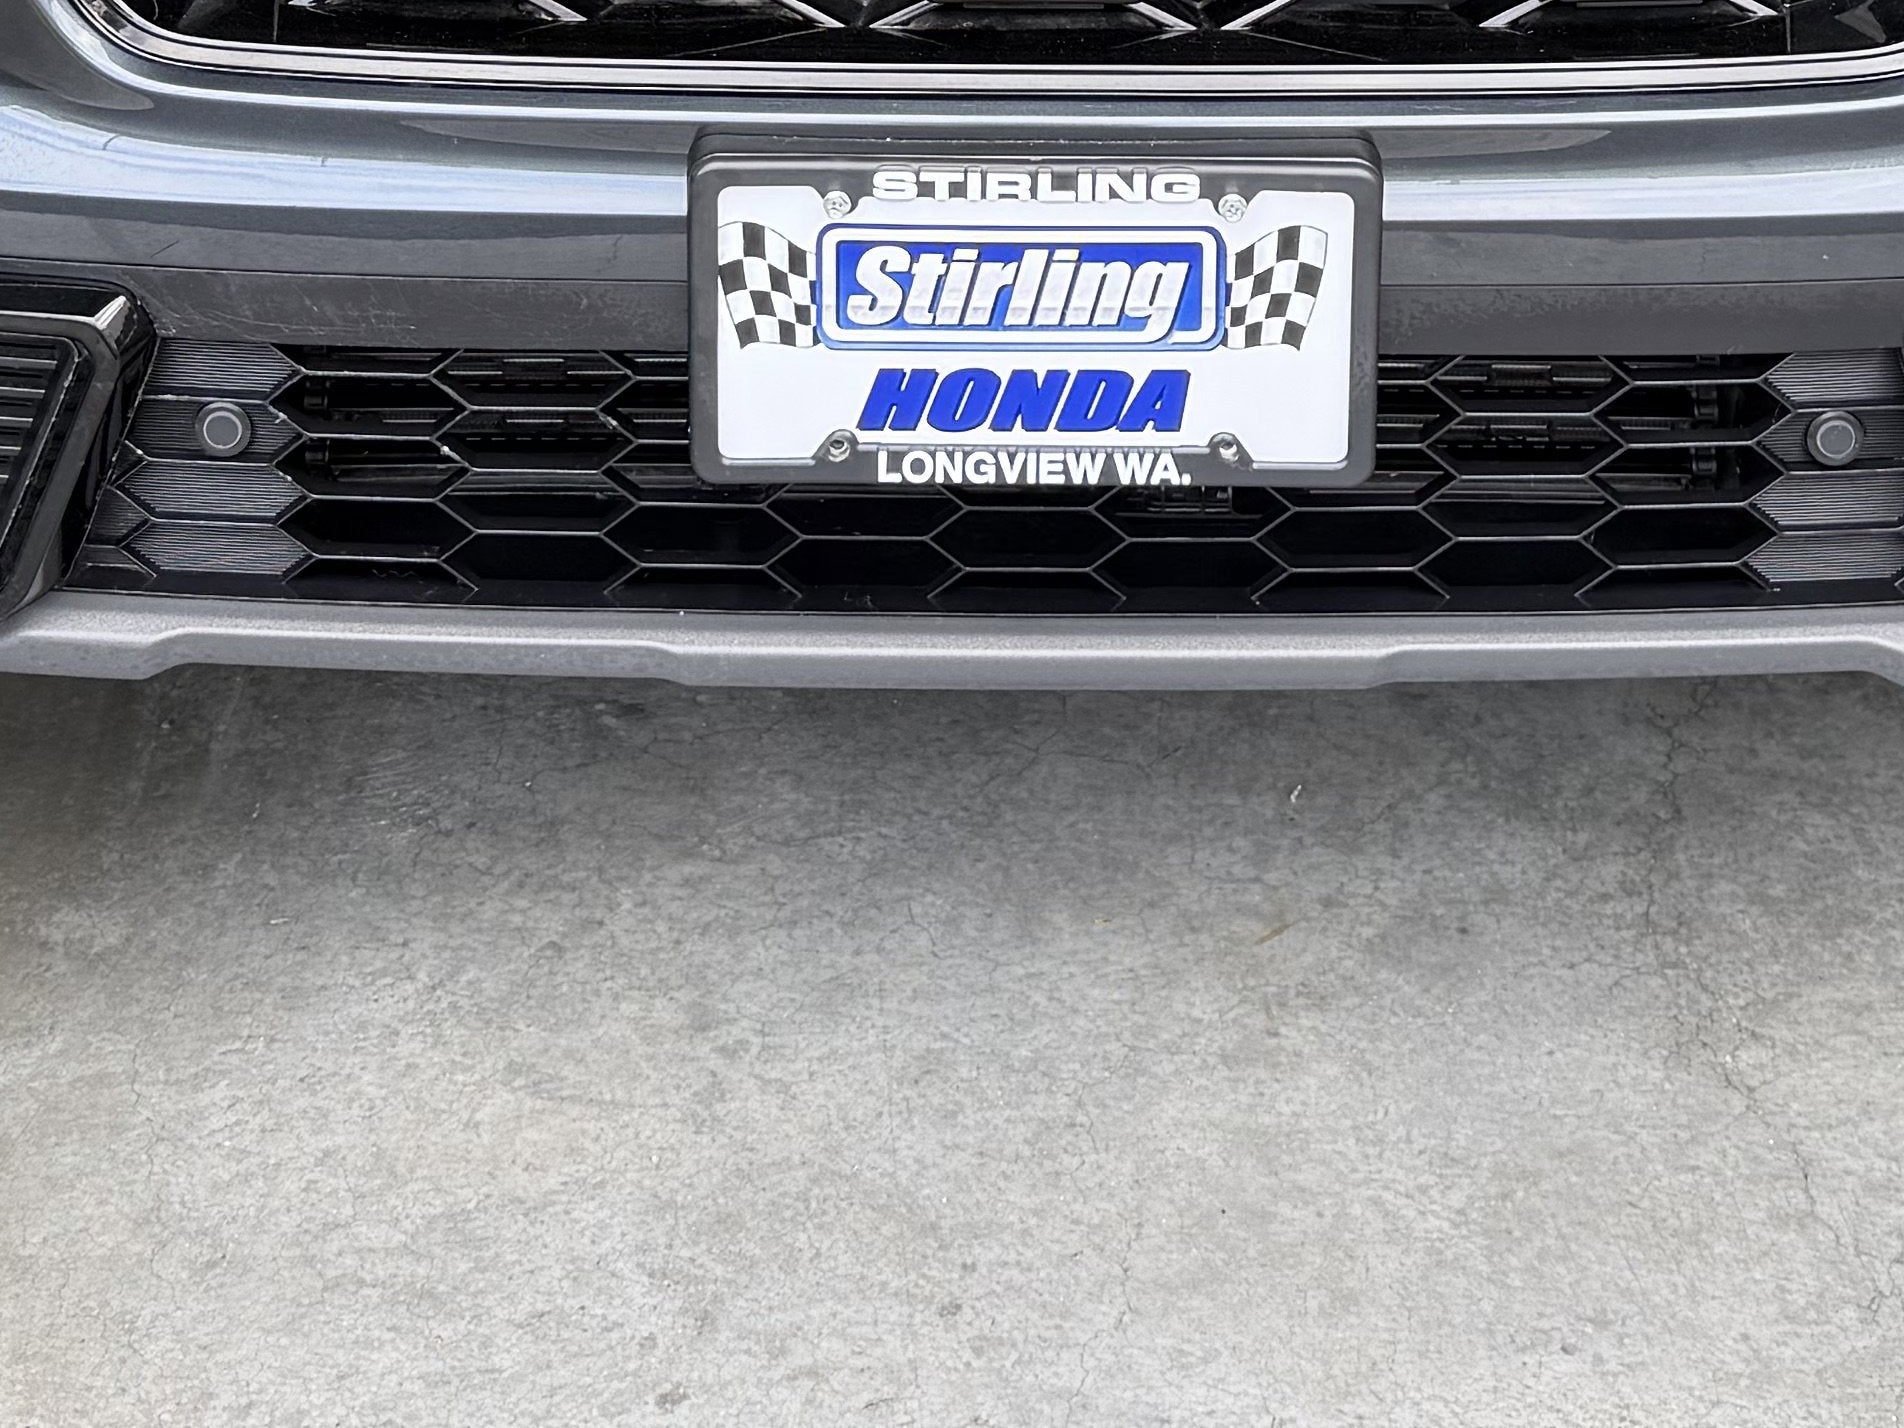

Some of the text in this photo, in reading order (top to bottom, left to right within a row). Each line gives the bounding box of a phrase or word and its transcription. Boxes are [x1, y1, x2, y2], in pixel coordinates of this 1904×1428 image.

[872, 168, 1201, 203] STIRLING
[846, 245, 1190, 342] Stirling
[856, 368, 1191, 432] HONDA
[877, 449, 1192, 486] LONGVIEW WA.
